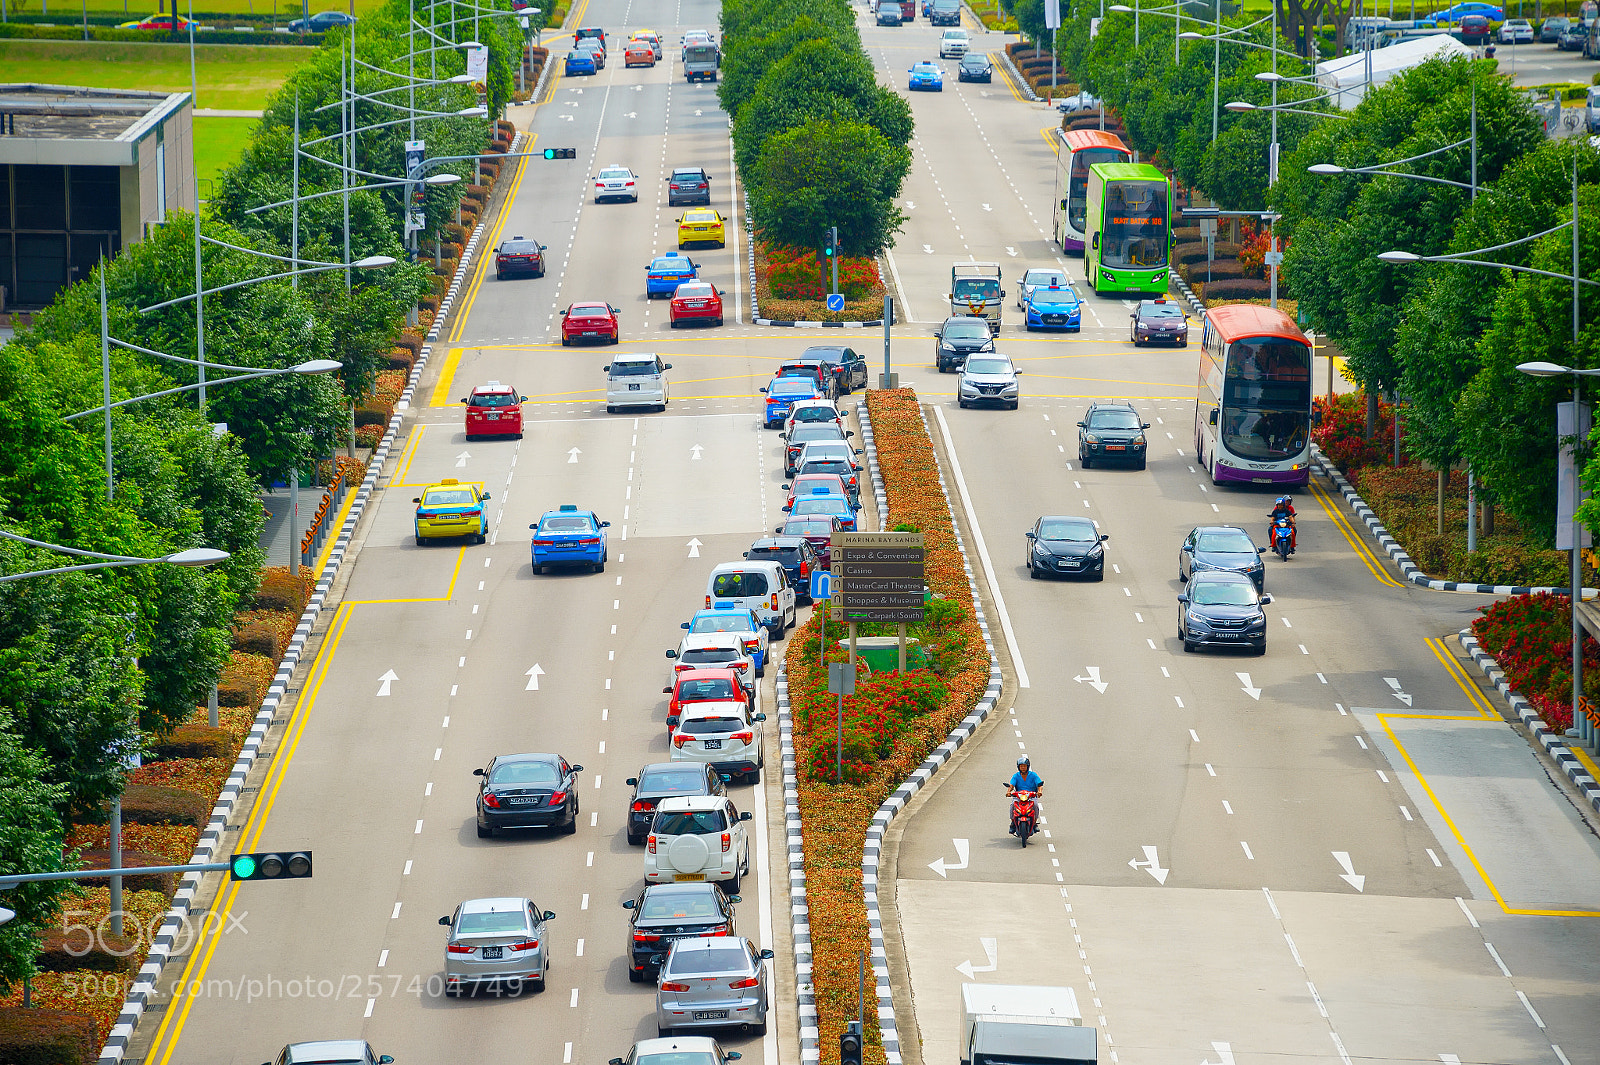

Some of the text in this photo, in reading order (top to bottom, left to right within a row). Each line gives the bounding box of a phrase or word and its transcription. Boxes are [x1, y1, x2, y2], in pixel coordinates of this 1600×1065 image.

[1130, 217, 1149, 225] BATOK
[847, 551, 866, 560] Expo
[876, 551, 920, 559] Convention
[847, 566, 873, 574] Casino
[847, 596, 878, 605] Shoppes
[868, 611, 923, 620] Carpark (South)
